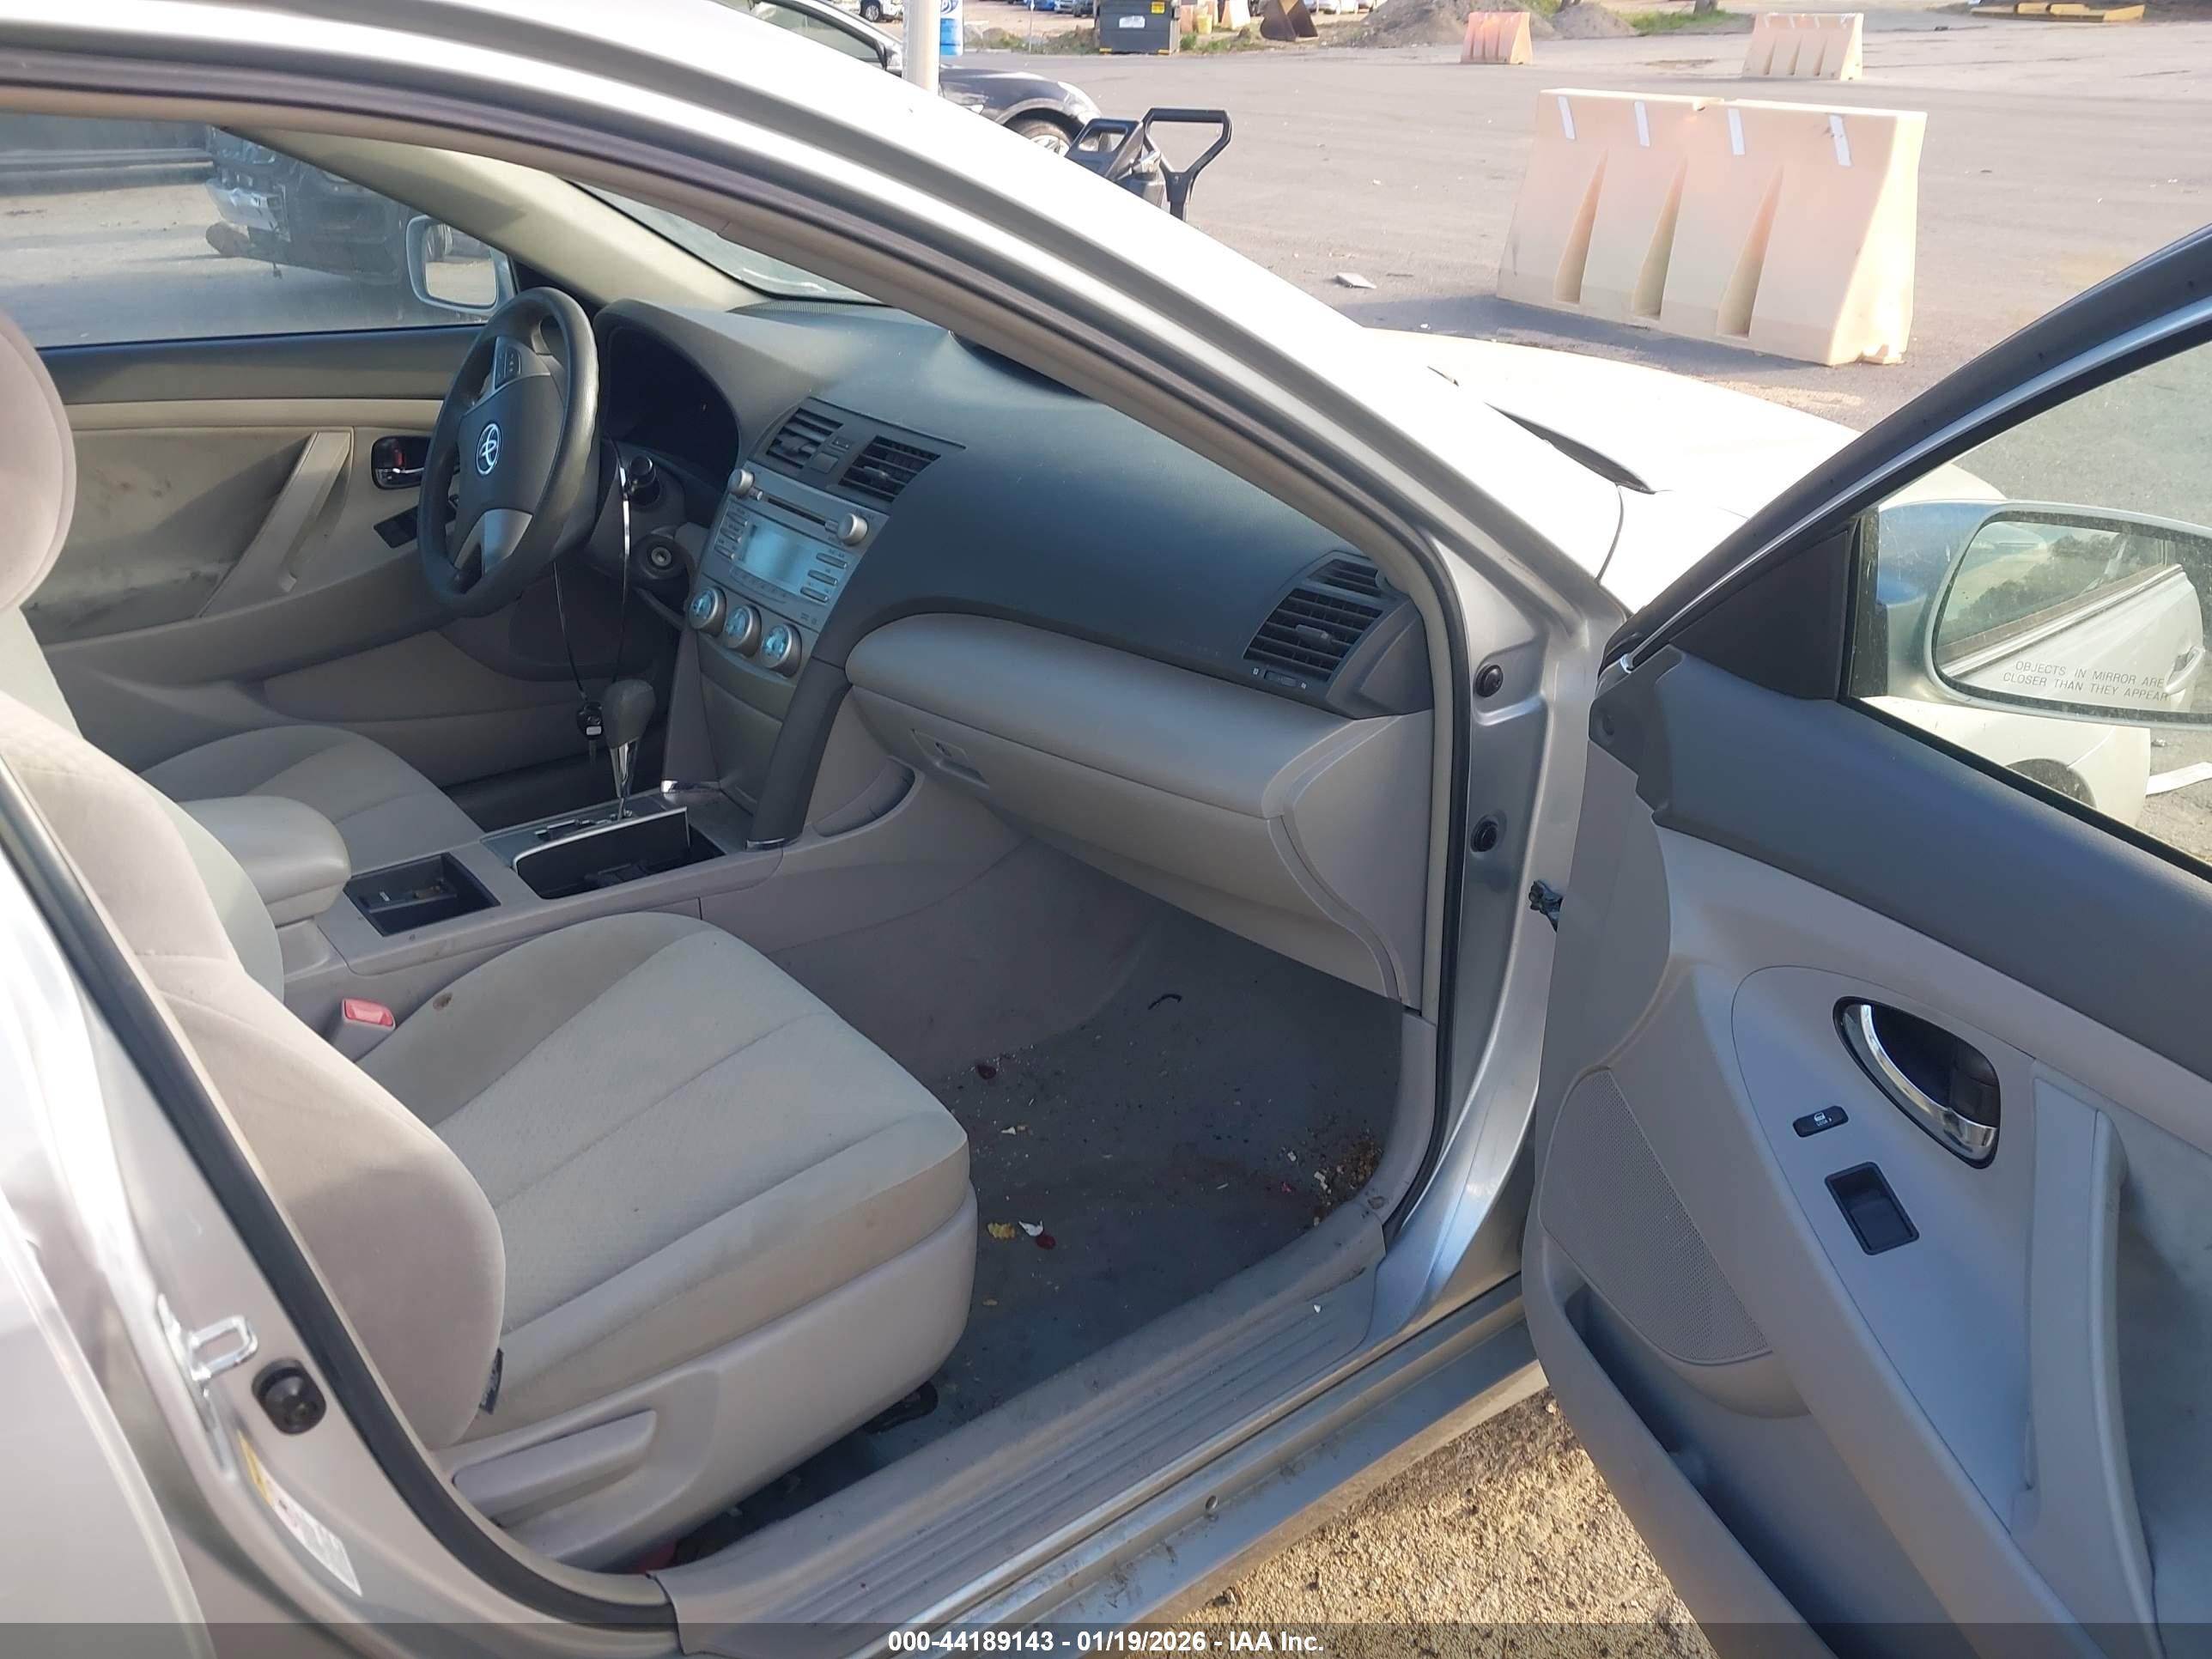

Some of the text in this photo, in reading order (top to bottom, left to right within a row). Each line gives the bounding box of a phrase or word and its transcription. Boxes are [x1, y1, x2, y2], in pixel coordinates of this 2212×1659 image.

[2002, 672, 2170, 702] CLOSER THAN THEY APPEAR
[2015, 659, 2165, 688] OBJECTS IN MIRROR ARE
